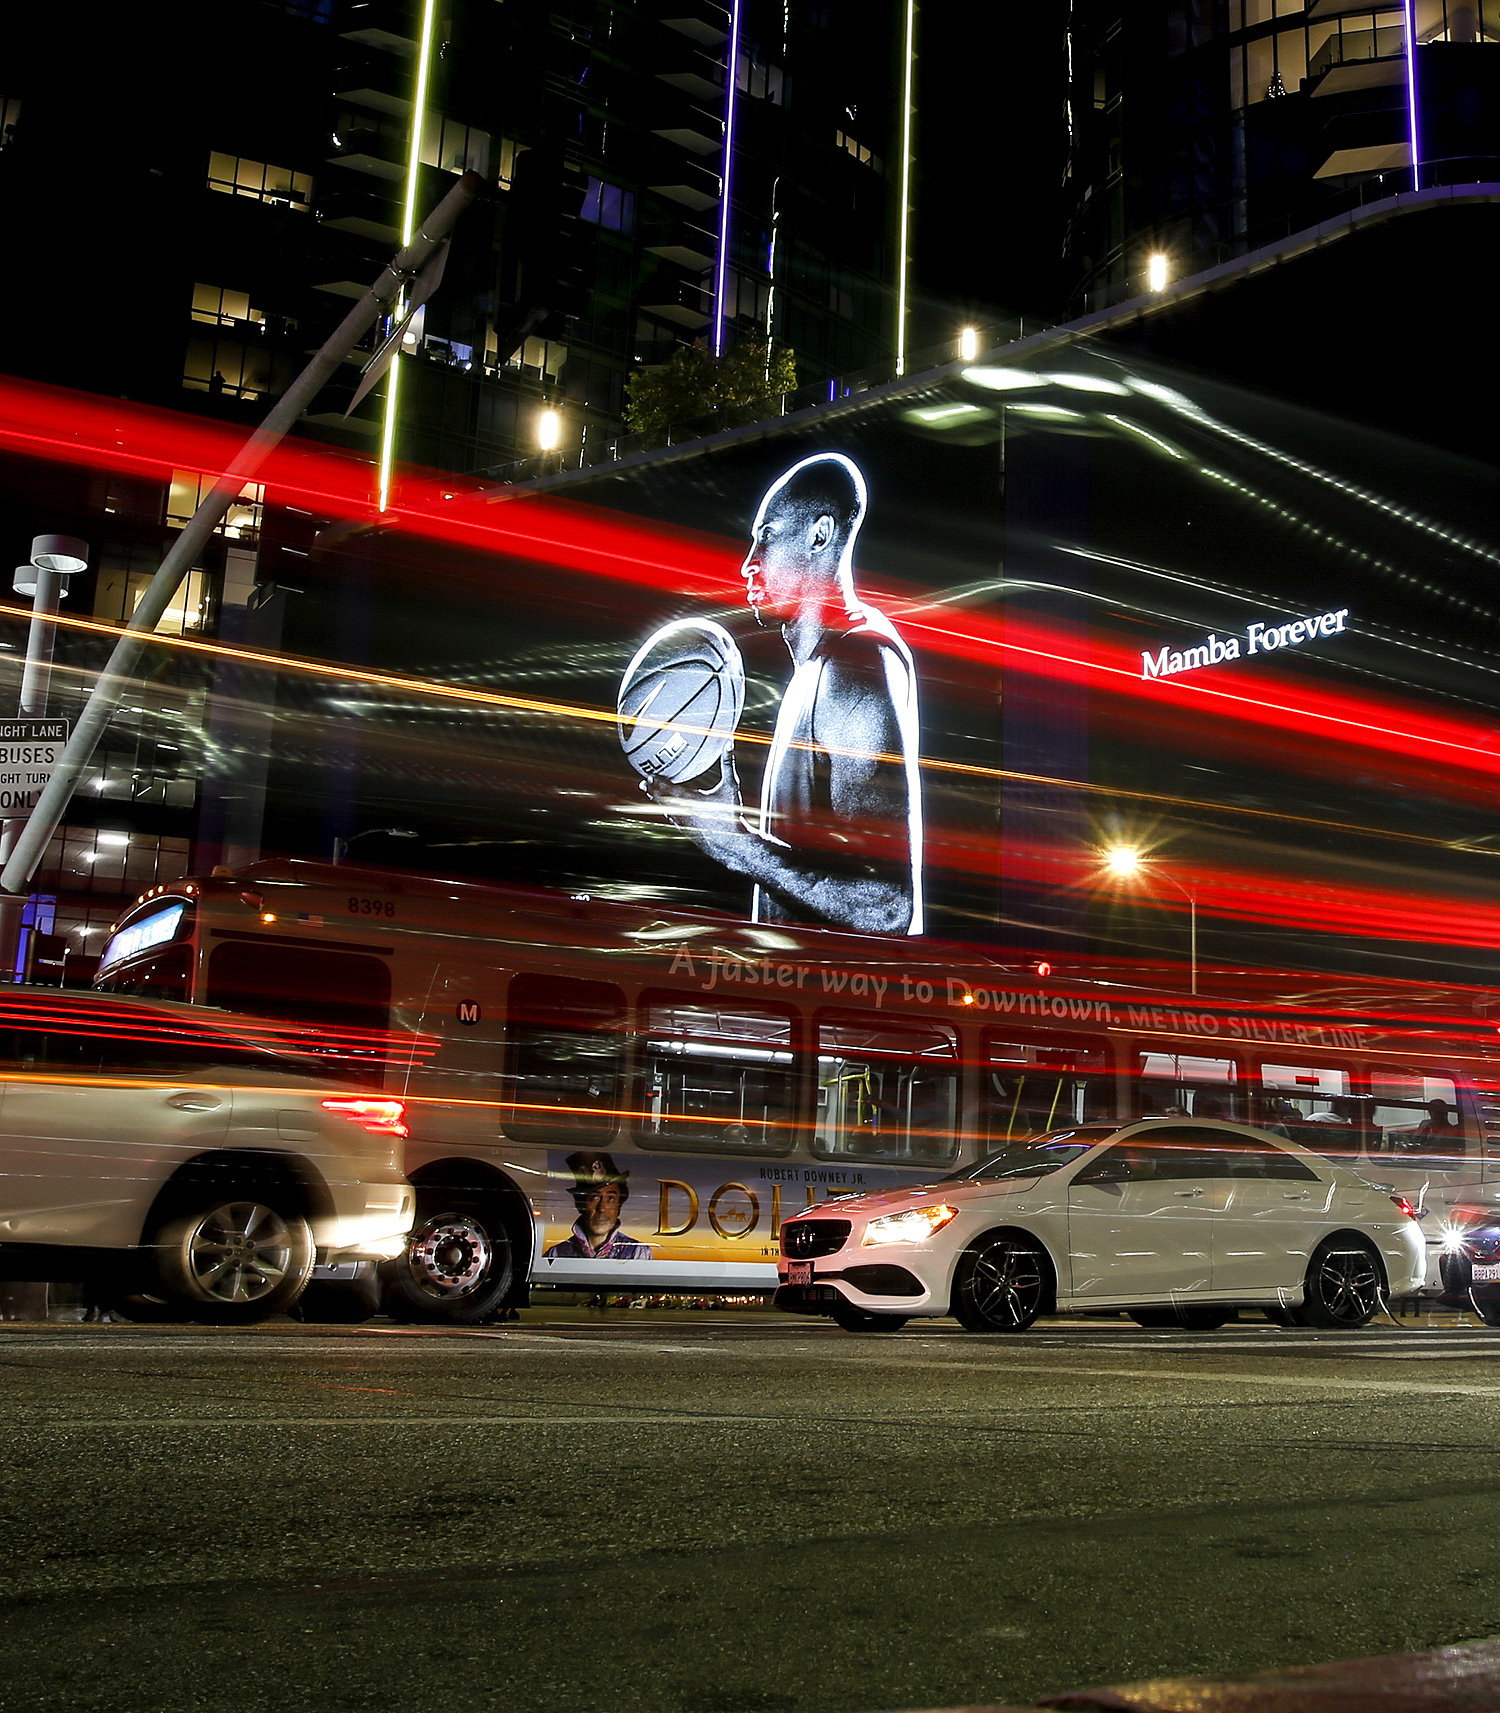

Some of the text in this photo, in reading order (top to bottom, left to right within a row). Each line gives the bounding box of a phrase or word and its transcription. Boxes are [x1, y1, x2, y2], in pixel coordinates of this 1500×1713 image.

[1141, 608, 1348, 680] Mamba Forever
[31, 726, 63, 737] LANE
[0, 747, 55, 763] BUSES
[0, 791, 42, 808] ONL
[347, 897, 395, 918] 8398
[668, 942, 1370, 1050] A faster way to Downtown. METRO SILVER LINE
[460, 1003, 477, 1022] M
[760, 1168, 867, 1185] ROBERT DOWNEY JR.
